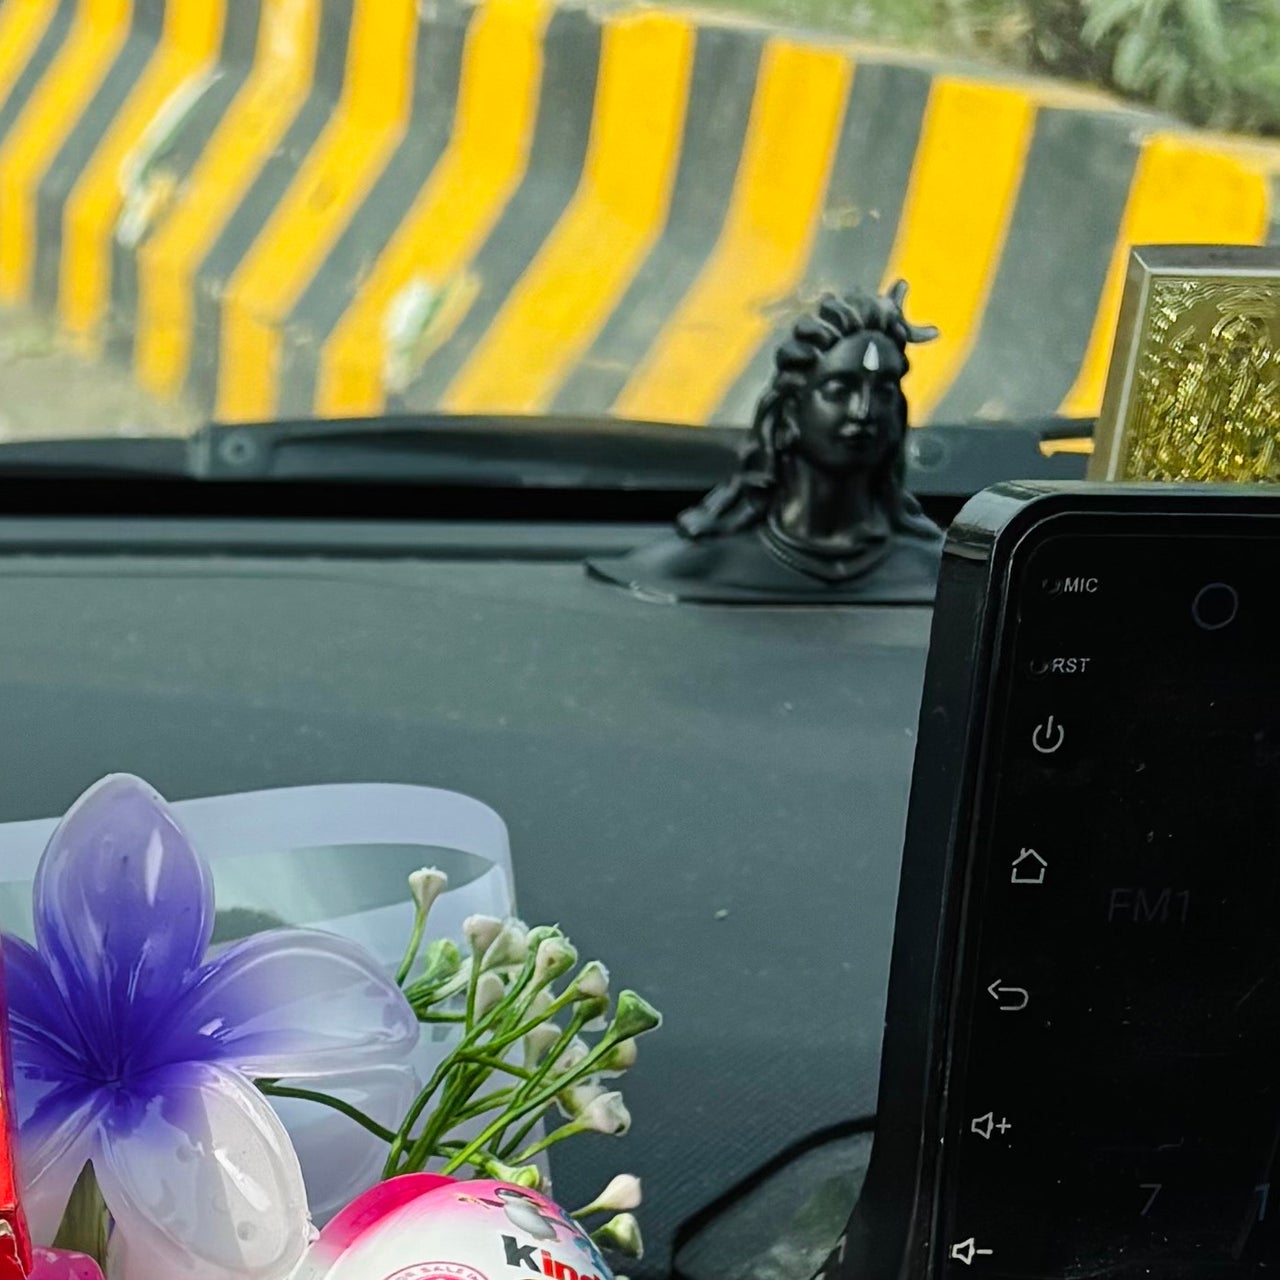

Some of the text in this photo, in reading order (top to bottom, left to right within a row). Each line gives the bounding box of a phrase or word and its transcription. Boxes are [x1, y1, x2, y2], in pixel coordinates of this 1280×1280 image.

[1063, 577, 1099, 593] MIC
[1051, 657, 1092, 673] RST
[1107, 888, 1193, 924] FM1
